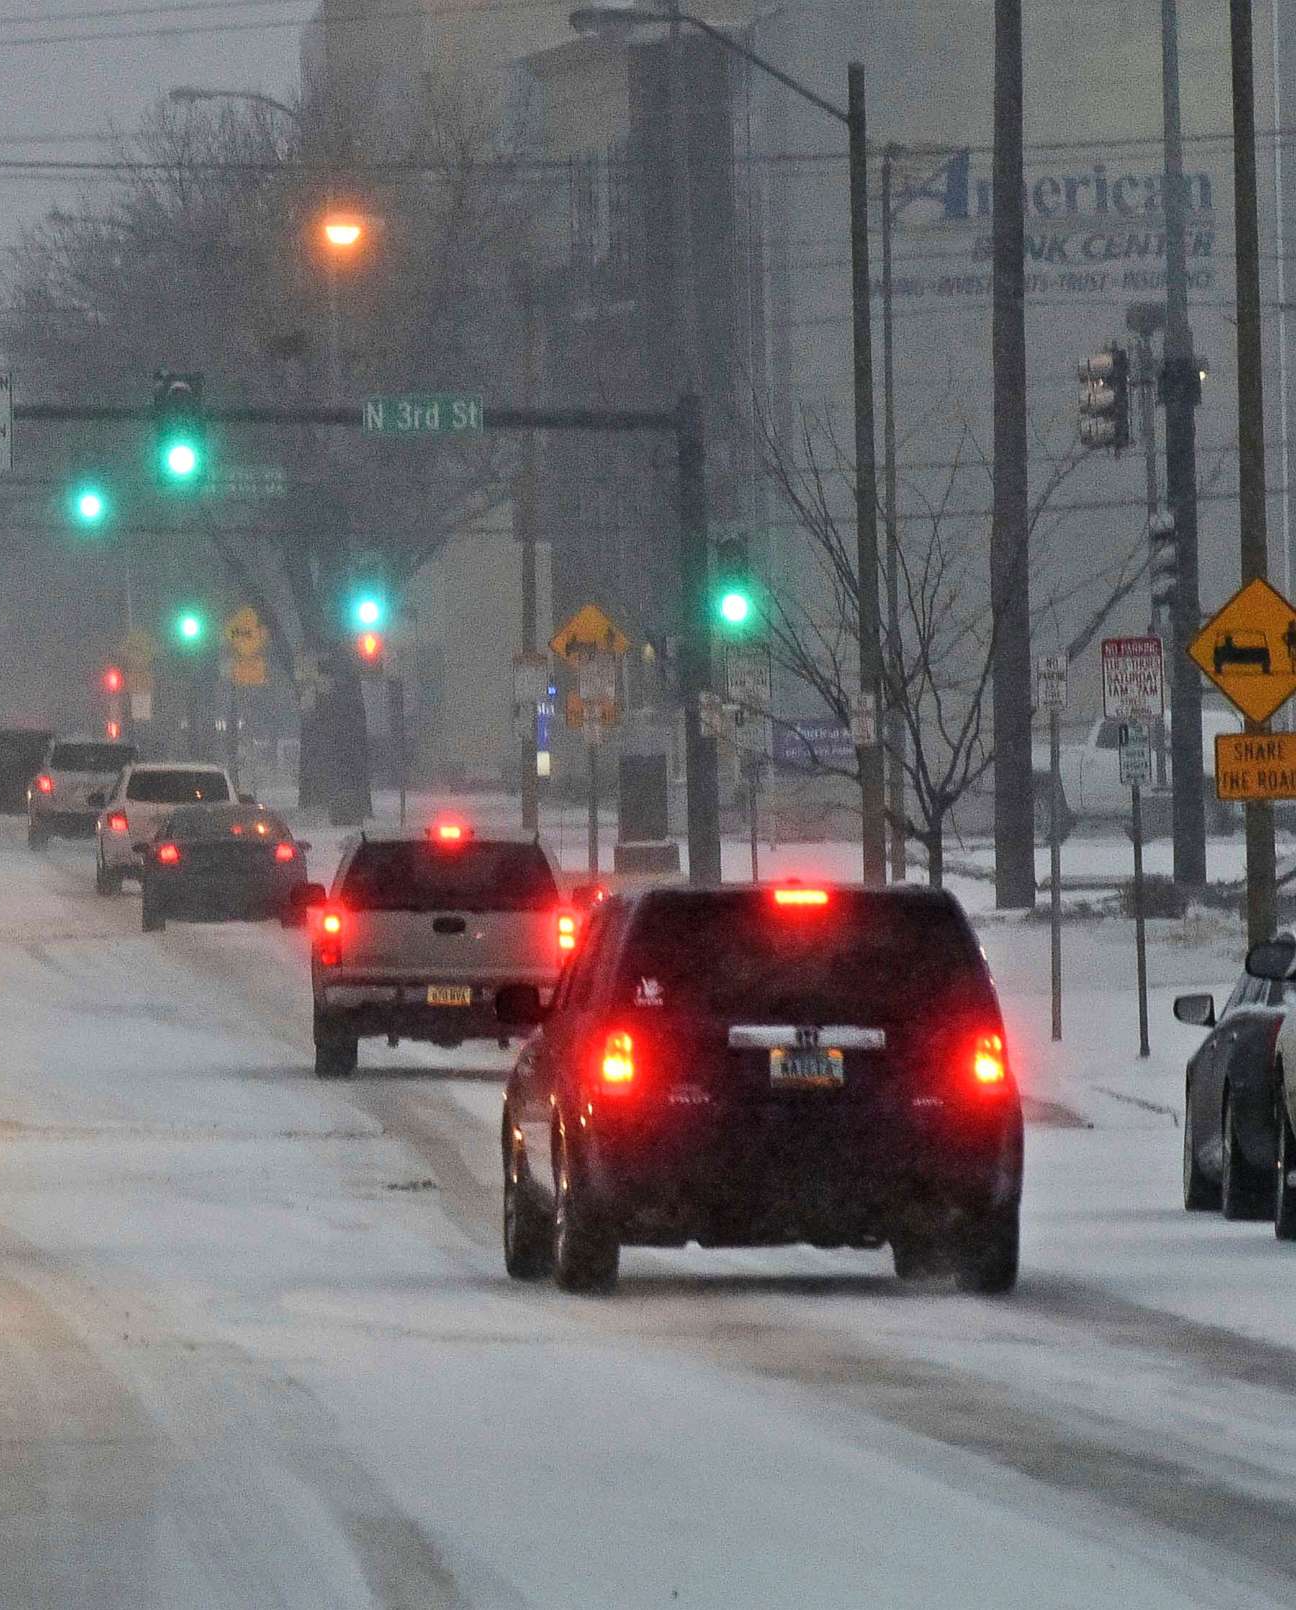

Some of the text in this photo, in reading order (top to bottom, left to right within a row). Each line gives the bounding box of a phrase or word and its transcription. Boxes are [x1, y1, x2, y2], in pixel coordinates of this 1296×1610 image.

[888, 147, 1212, 219] Aerican
[972, 231, 1214, 262] BNK CENTR
[367, 401, 384, 431] N
[396, 400, 440, 431] 3rd
[1233, 742, 1283, 761] SHARE
[1223, 771, 1249, 791] THE
